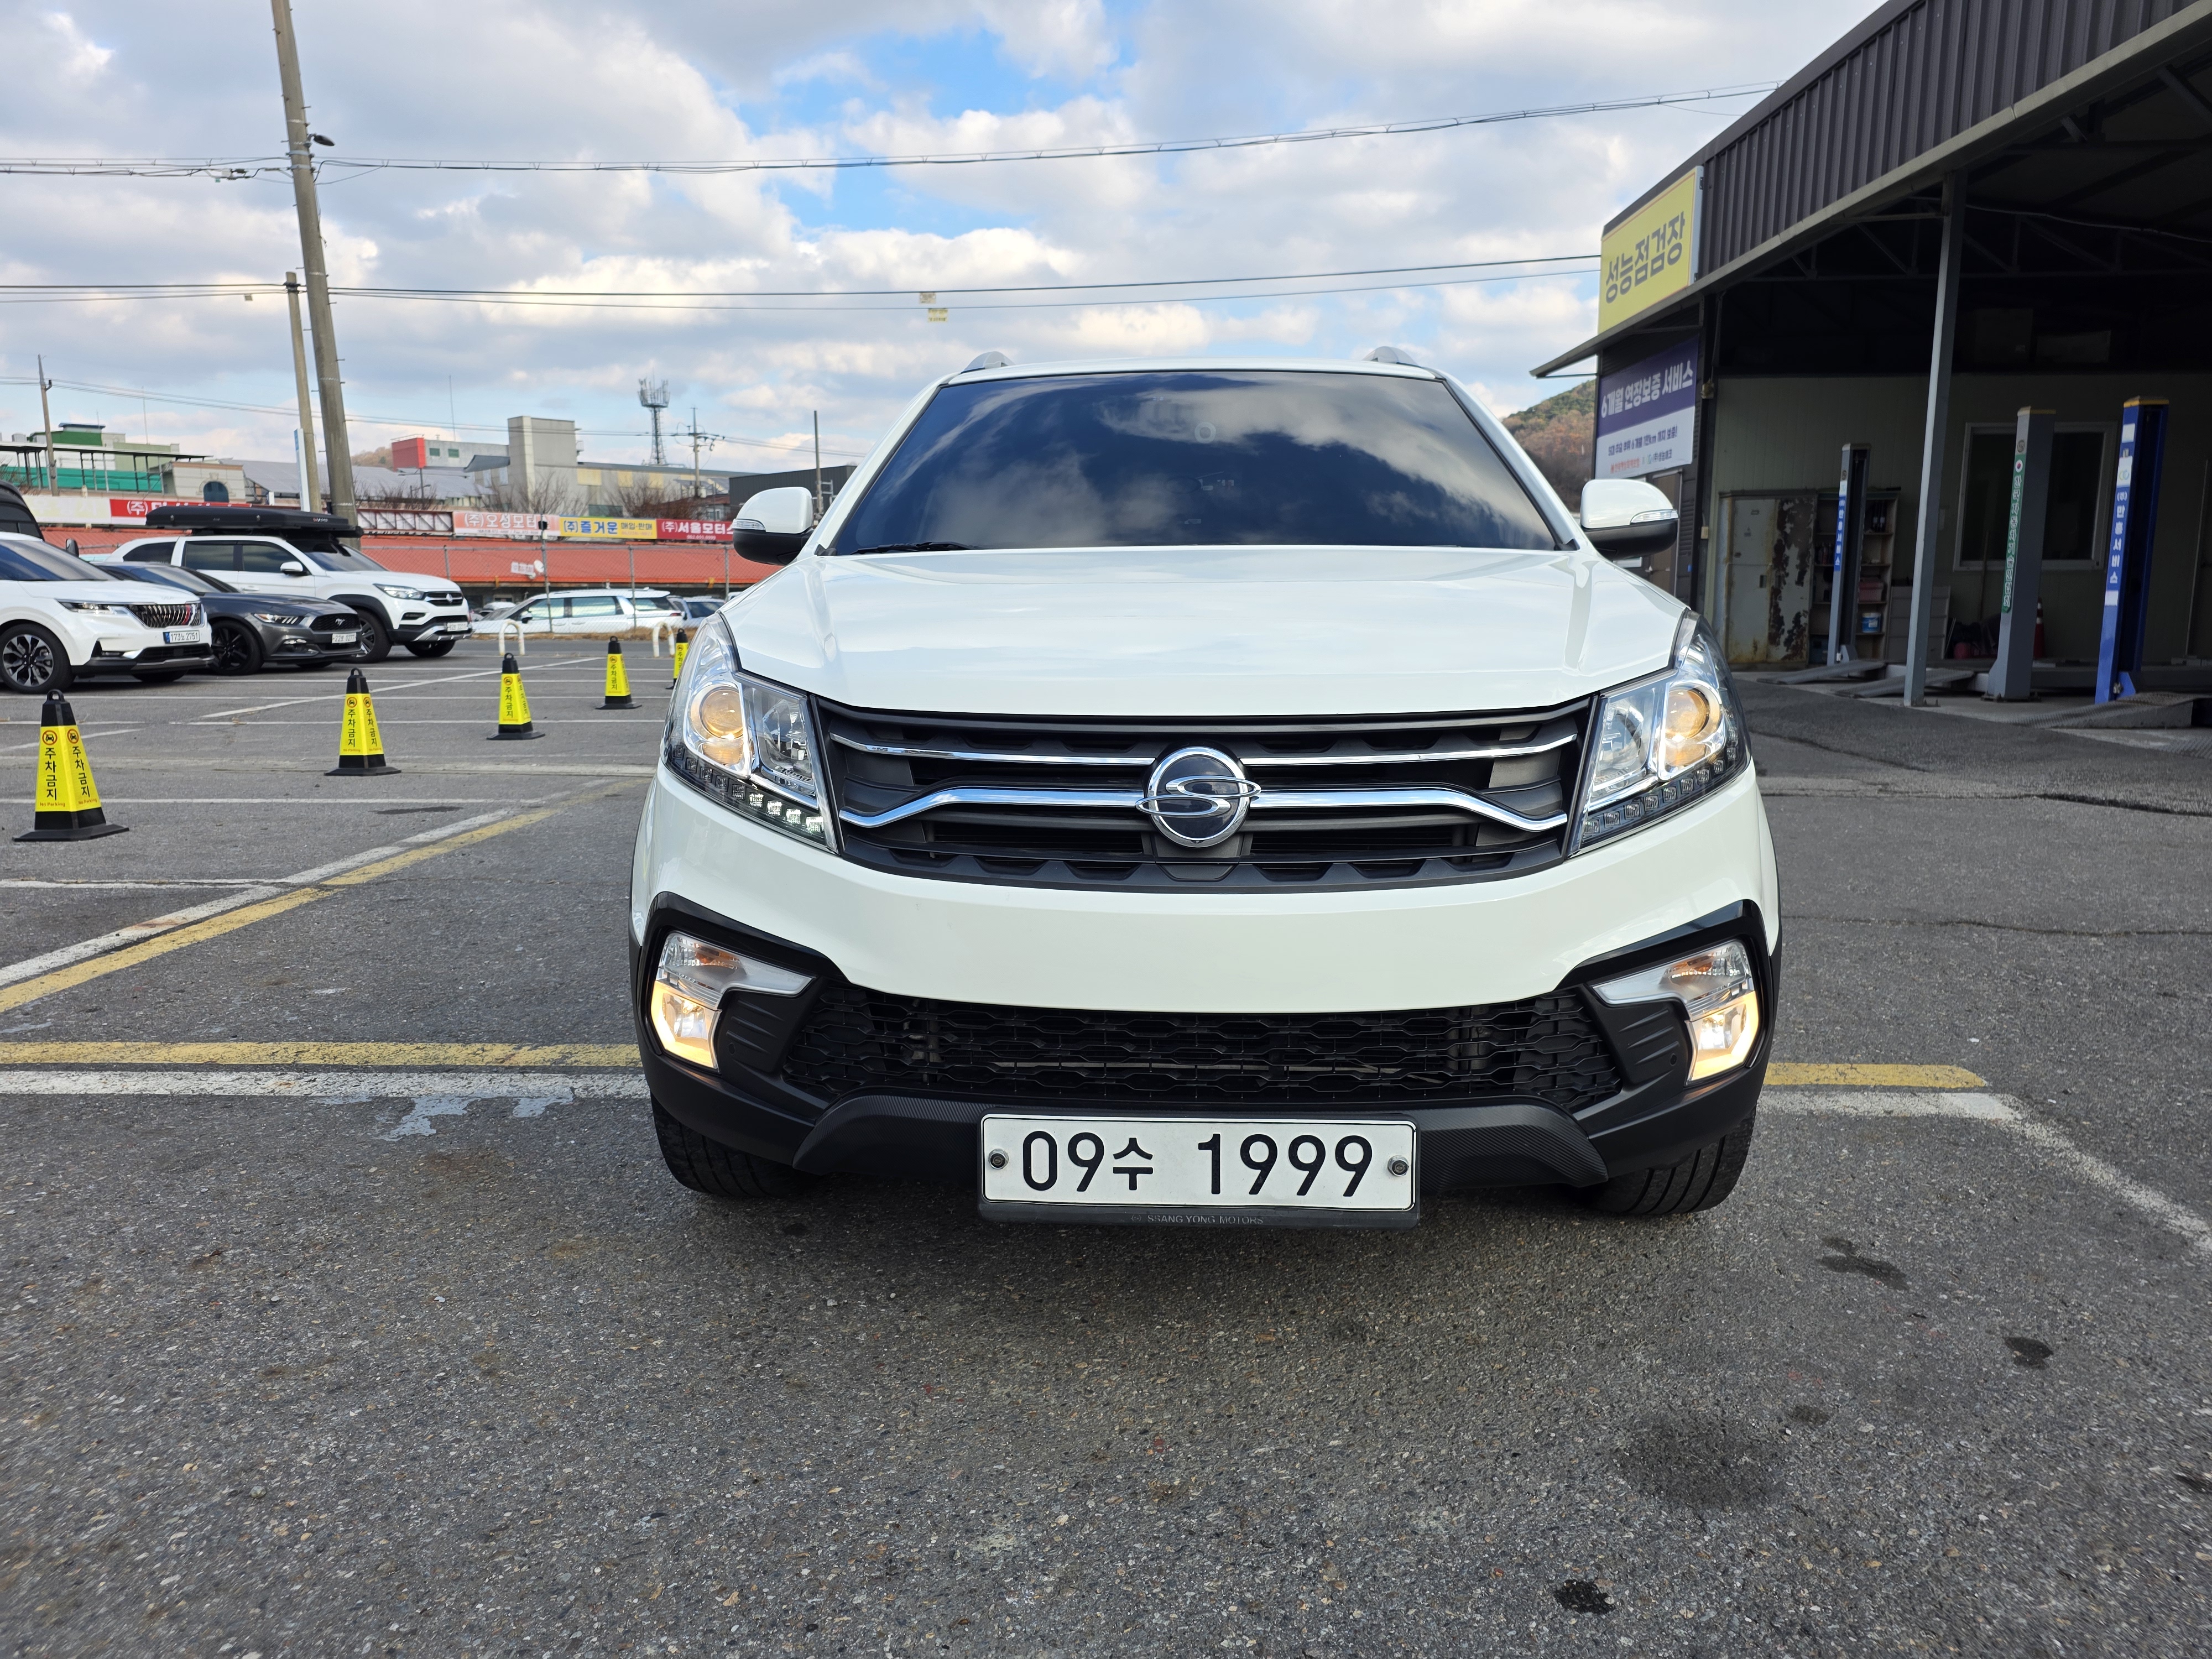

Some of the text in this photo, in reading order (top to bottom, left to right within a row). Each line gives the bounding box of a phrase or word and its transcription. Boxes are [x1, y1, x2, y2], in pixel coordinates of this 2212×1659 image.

[1606, 211, 1685, 304] 성능점검장
[1601, 360, 1693, 418] 6개월 연장보증 서비스
[366, 709, 377, 747] 주차금지
[505, 687, 513, 718] 주차금지
[45, 748, 57, 800] 주차금지
[72, 747, 90, 797] 주차금지
[1023, 1130, 1373, 1197] 09수 1999
[1147, 1215, 1264, 1224] SSANG YONG MOTORS
